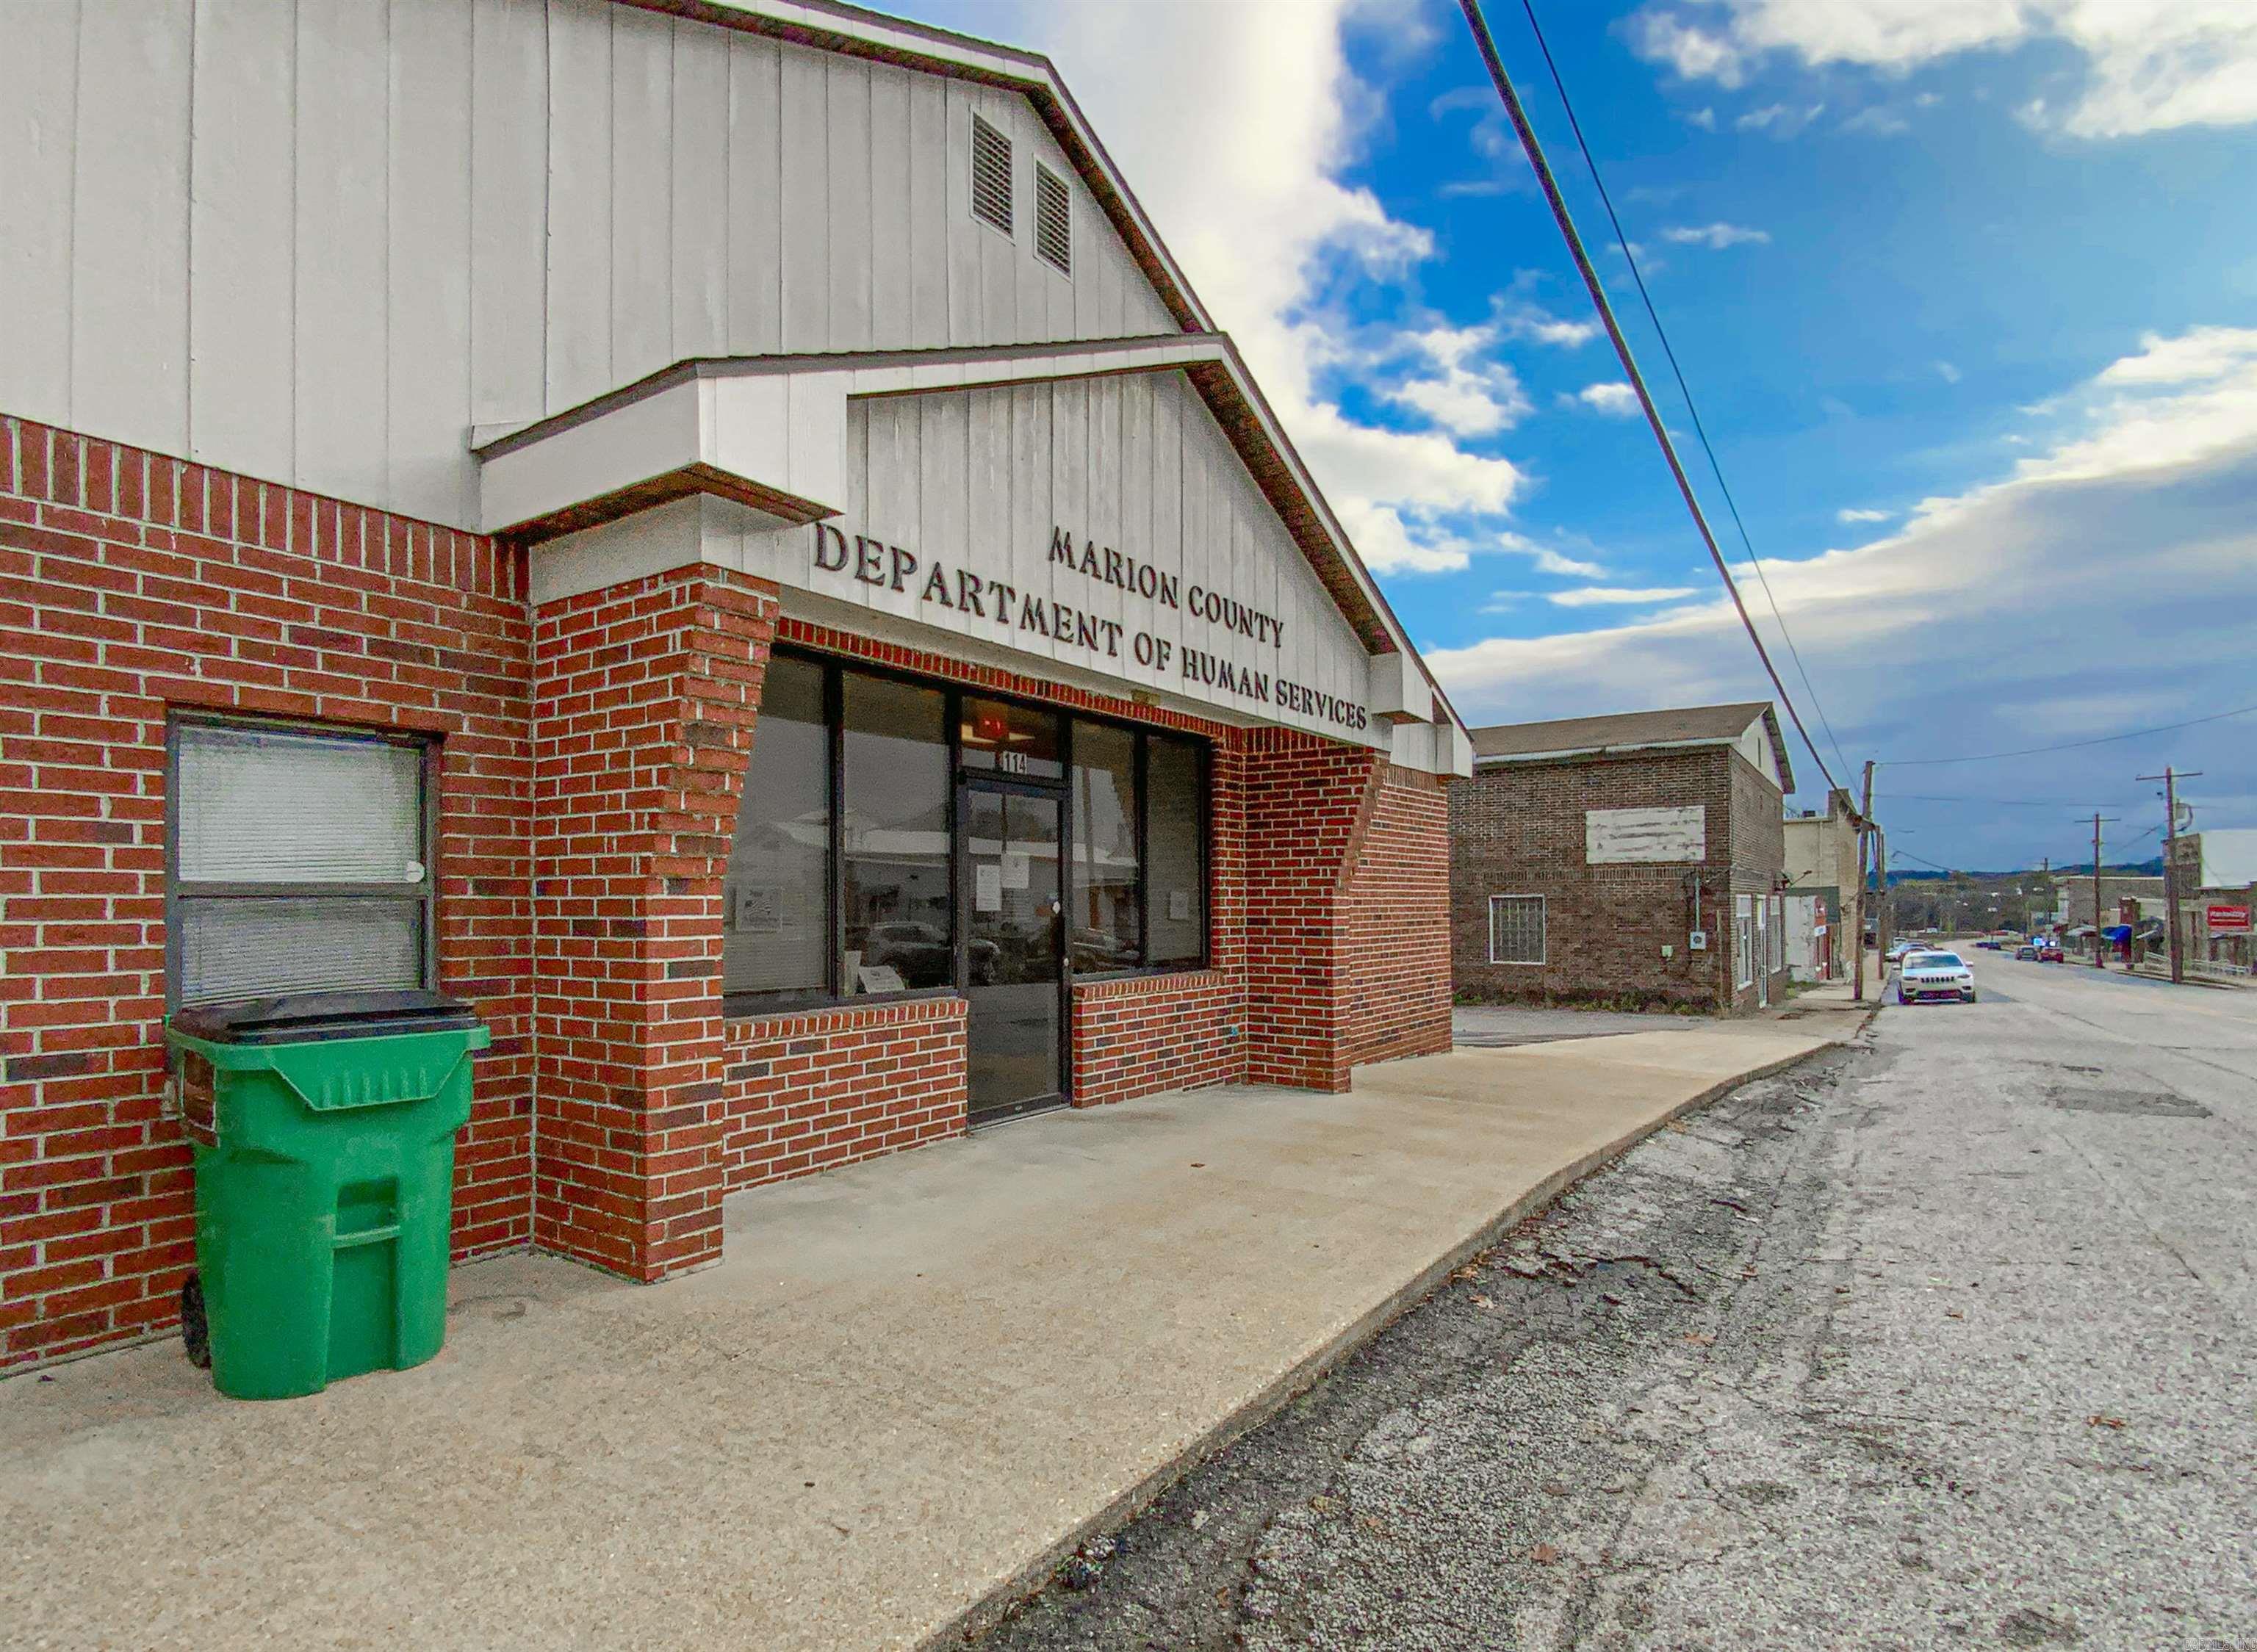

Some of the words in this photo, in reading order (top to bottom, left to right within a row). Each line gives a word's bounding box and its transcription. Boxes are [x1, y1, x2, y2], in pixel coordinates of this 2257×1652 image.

[815, 522, 1123, 657] DEPARTMENT
[1134, 632, 1171, 671] OF
[1181, 646, 1269, 702] HUMAN
[1275, 679, 1367, 730] SERVICES
[1048, 526, 1178, 609] MARION
[1189, 585, 1284, 648] COUNTY
[1003, 751, 1026, 773] 114
